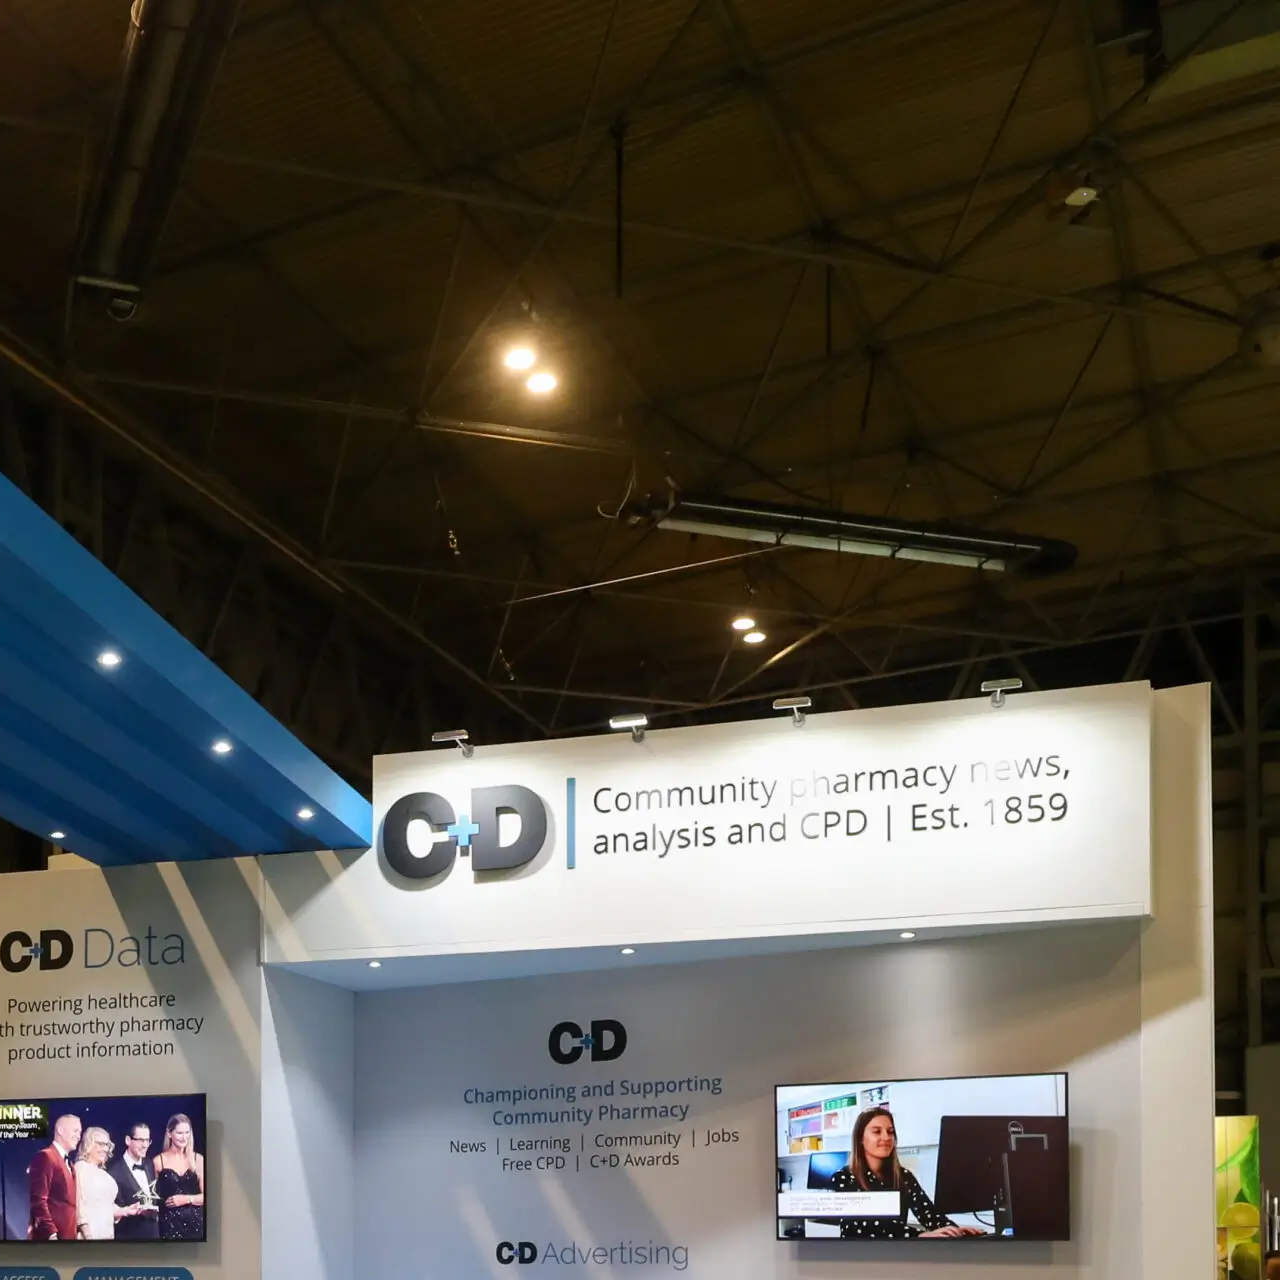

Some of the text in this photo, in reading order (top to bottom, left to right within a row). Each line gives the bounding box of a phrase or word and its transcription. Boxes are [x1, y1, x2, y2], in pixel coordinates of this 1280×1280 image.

[594, 754, 1070, 813] Community pharmacy news,
[382, 784, 547, 879] C+D
[593, 821, 716, 858] analysis
[727, 814, 786, 845] and
[801, 809, 867, 839] CPD
[912, 803, 969, 832] Est.
[984, 793, 1068, 826] 1859
[0, 926, 185, 973] C+D Data
[8, 993, 176, 1015] Powering healthcare
[20, 1018, 115, 1038] trustworthy
[120, 1016, 204, 1037] pharmacy
[548, 1019, 628, 1065] C+D
[8, 1041, 174, 1064] product information
[463, 1075, 723, 1105] Championing and Supporting
[492, 1103, 690, 1126] Community Pharmacy
[450, 1140, 487, 1153] News
[510, 1136, 571, 1151] Learning
[594, 1130, 682, 1149] Community
[705, 1128, 740, 1147] Jobs
[502, 1158, 533, 1172] Free
[536, 1156, 566, 1170] CPD
[590, 1154, 620, 1168] C+D
[624, 1152, 680, 1167] Awards
[496, 1241, 689, 1271] C+D Advertising
